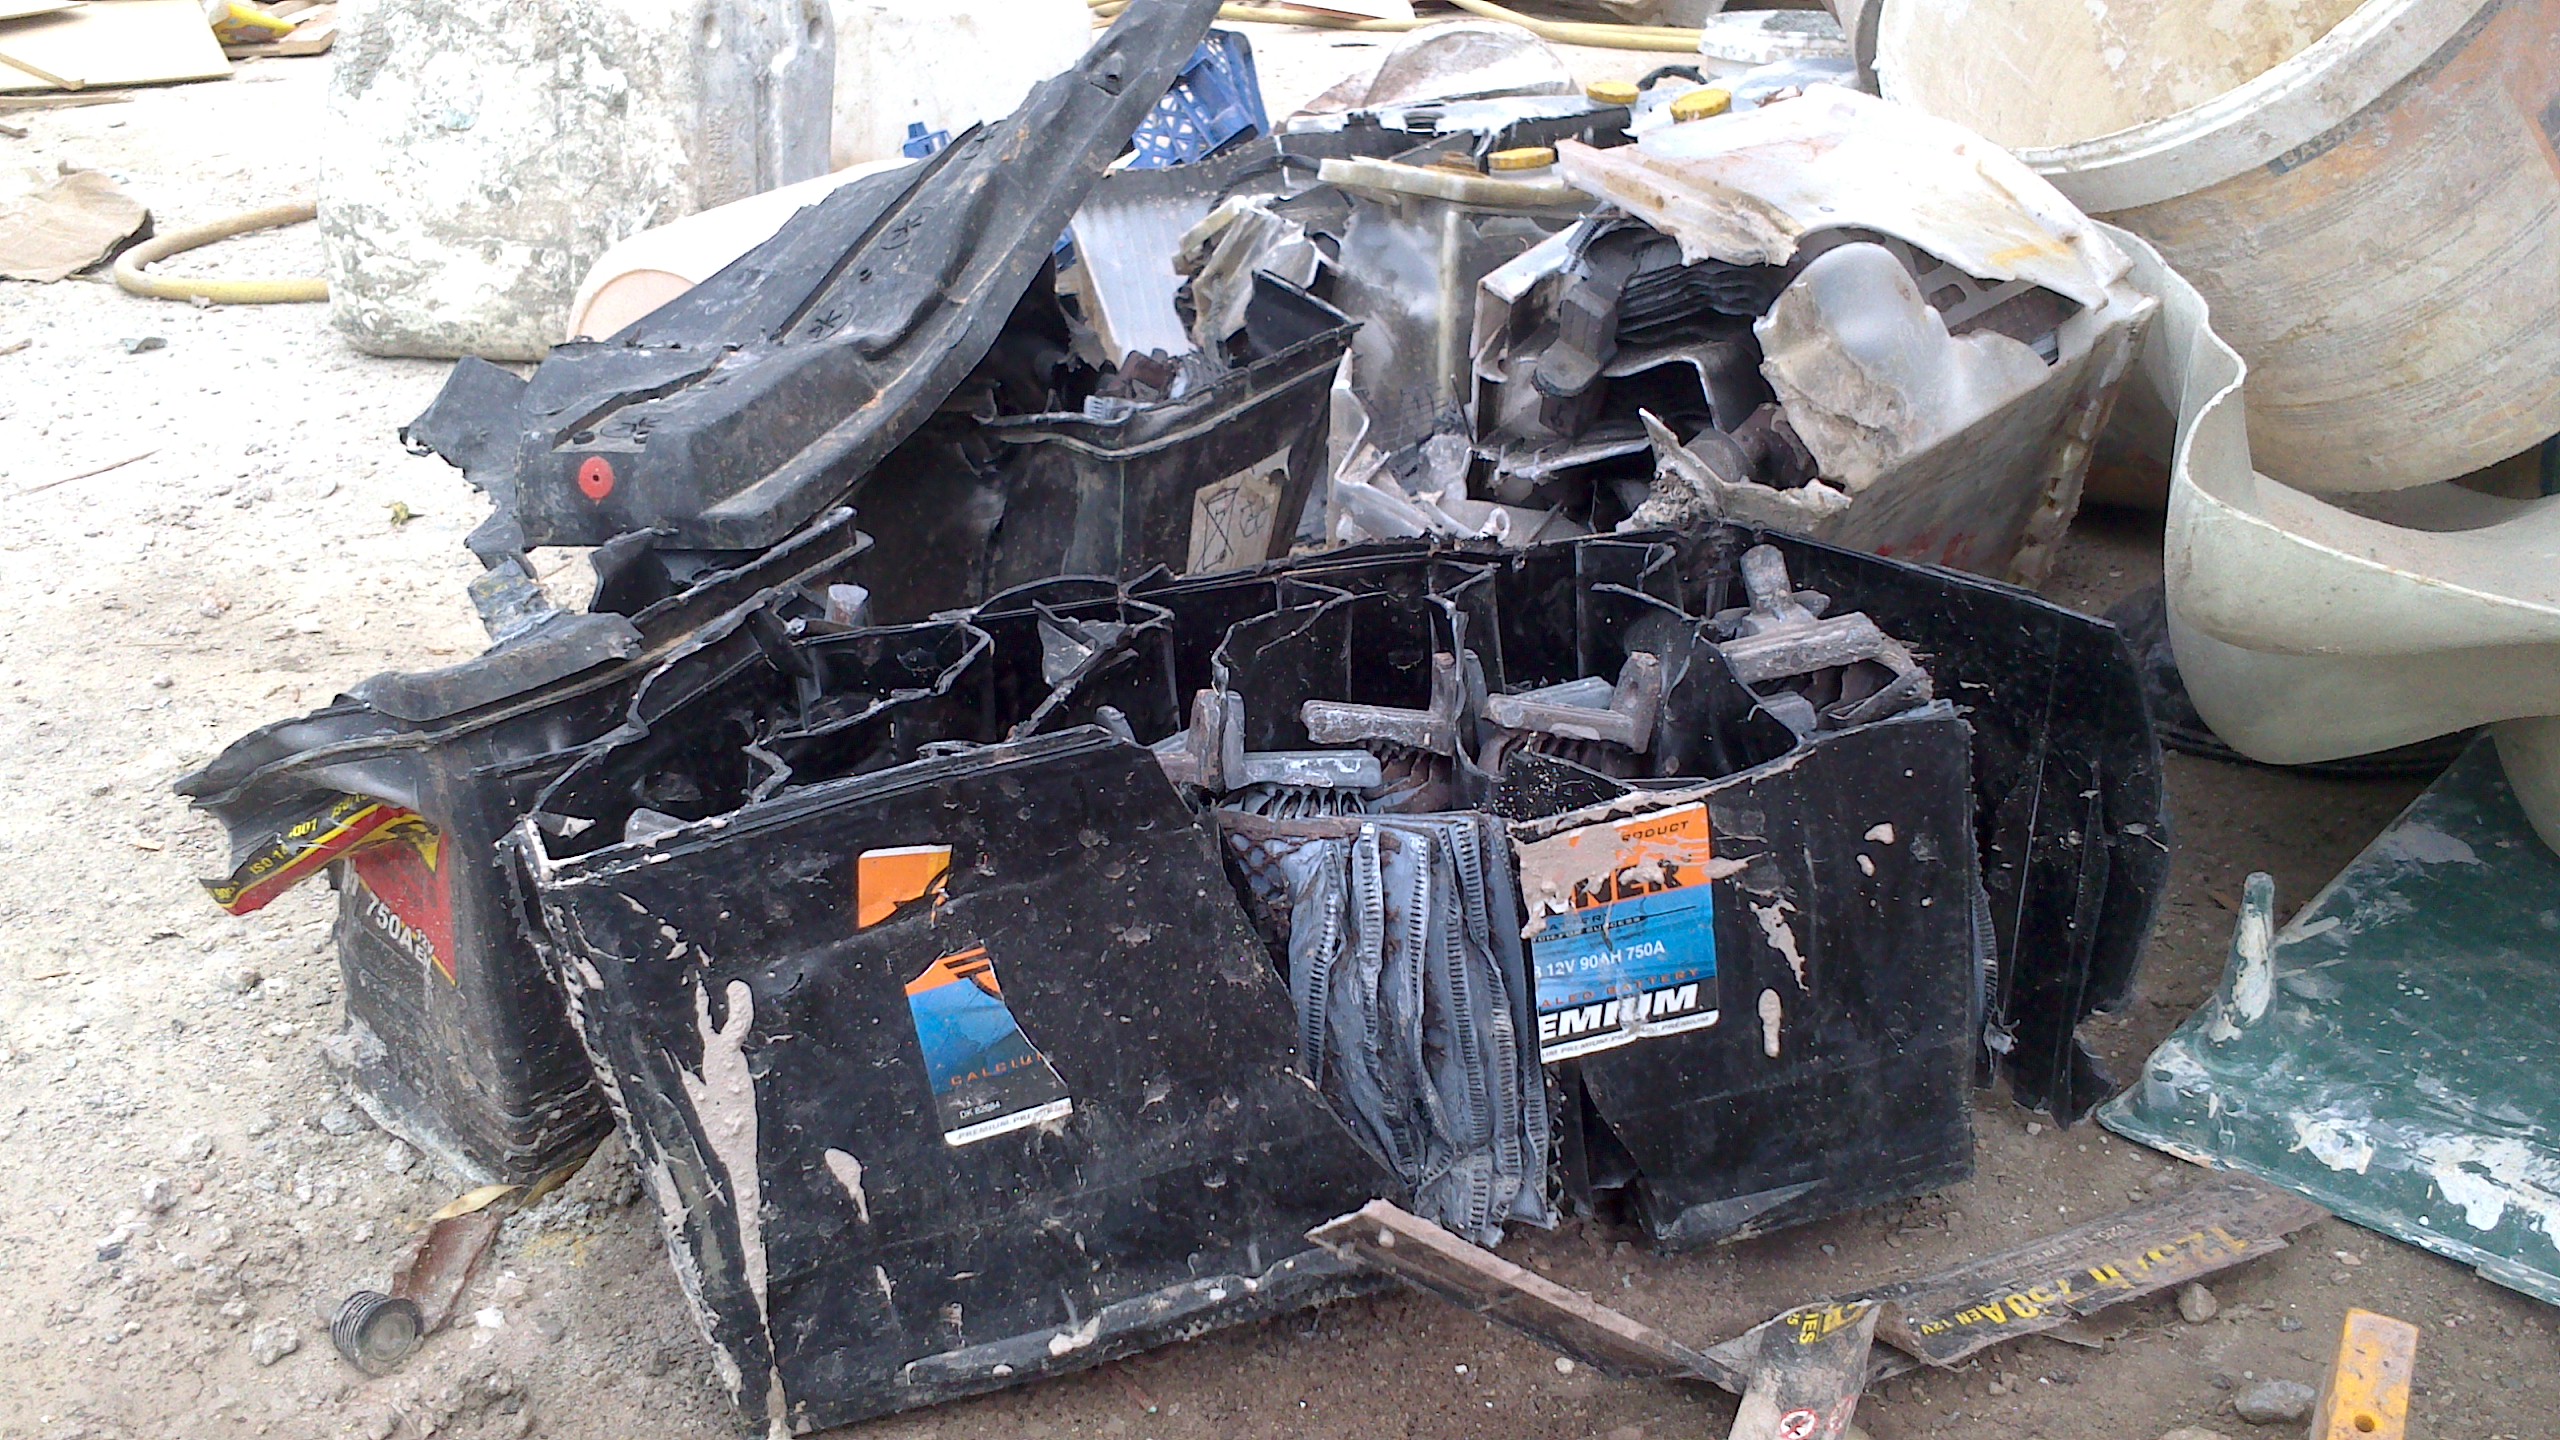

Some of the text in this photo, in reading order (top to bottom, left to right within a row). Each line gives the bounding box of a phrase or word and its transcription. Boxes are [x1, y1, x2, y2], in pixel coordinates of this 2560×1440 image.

[250, 857, 274, 875] ISO
[1547, 960, 1576, 977] 12V
[1580, 950, 1622, 970] 90AH
[1626, 939, 1666, 961] 750A
